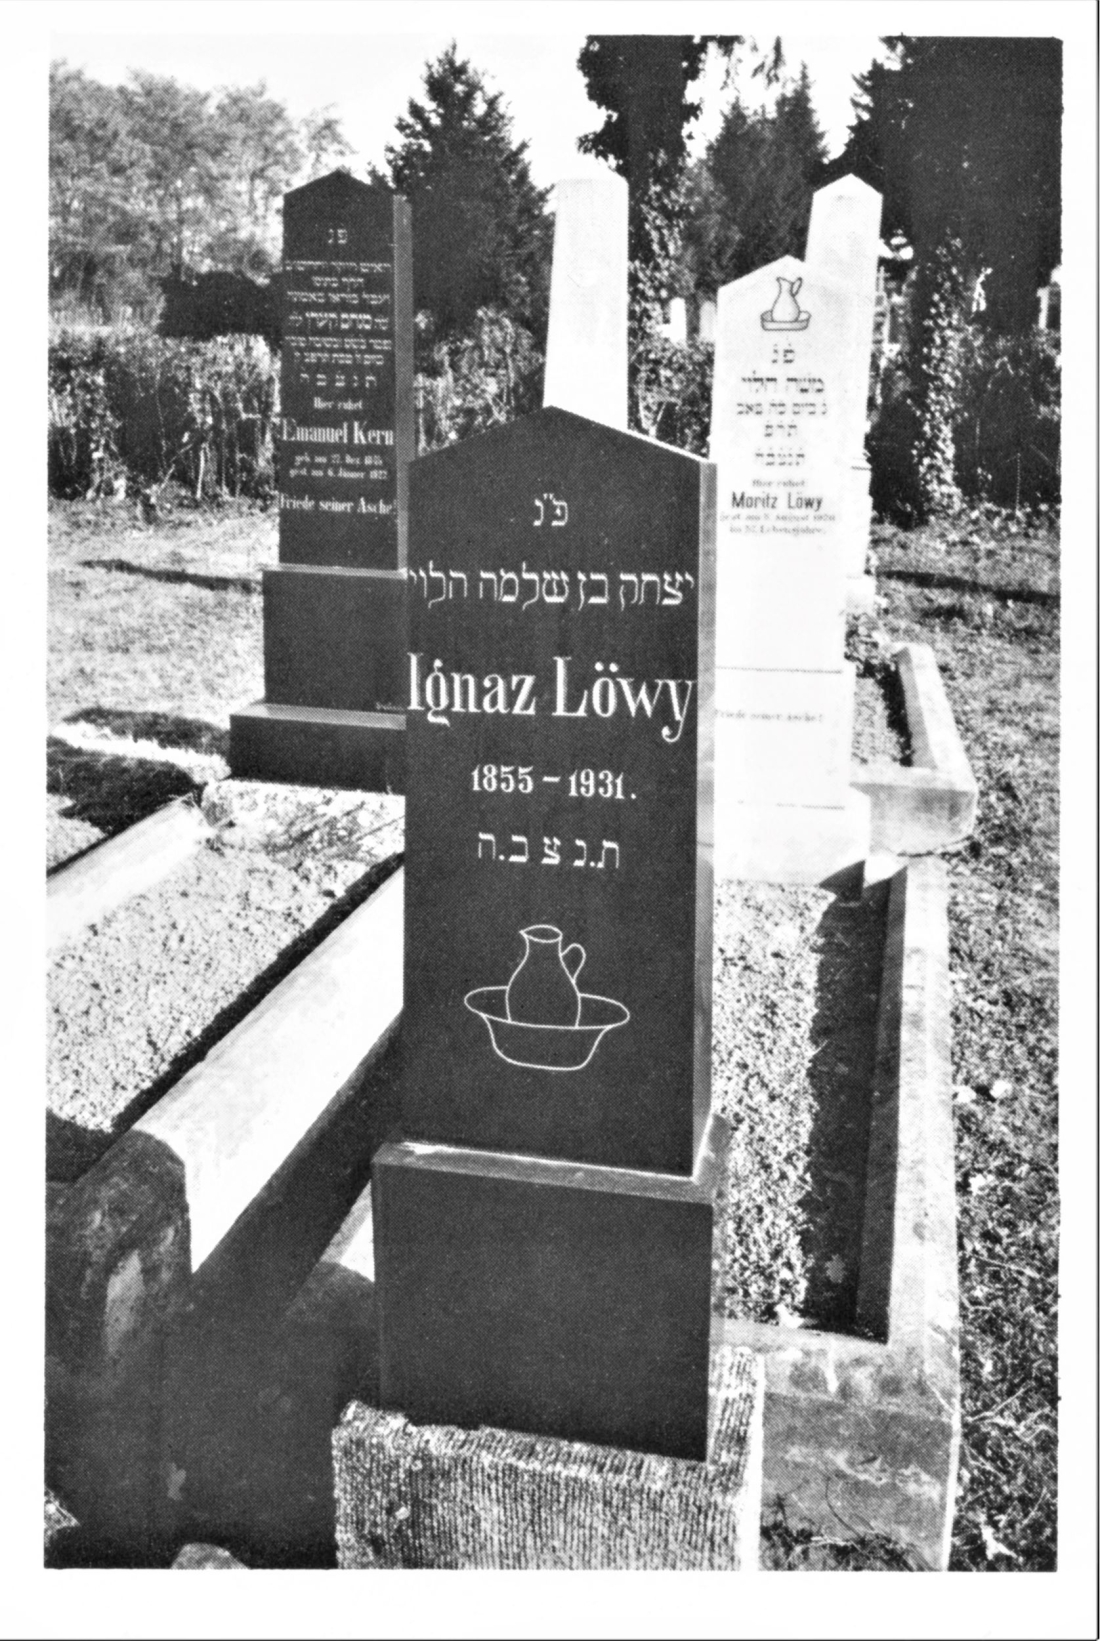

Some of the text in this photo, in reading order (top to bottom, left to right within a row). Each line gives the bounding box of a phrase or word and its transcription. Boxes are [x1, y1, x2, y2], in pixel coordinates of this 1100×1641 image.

[282, 418, 394, 446] Emanuel Kern
[319, 496, 354, 513] seiner
[731, 490, 823, 512] Moritz Löwy
[408, 559, 695, 611] יצחק בן שלמה הלוי
[407, 652, 697, 743] Ignaz Löwy
[471, 763, 534, 794] 1855
[568, 768, 637, 800] 1931.
